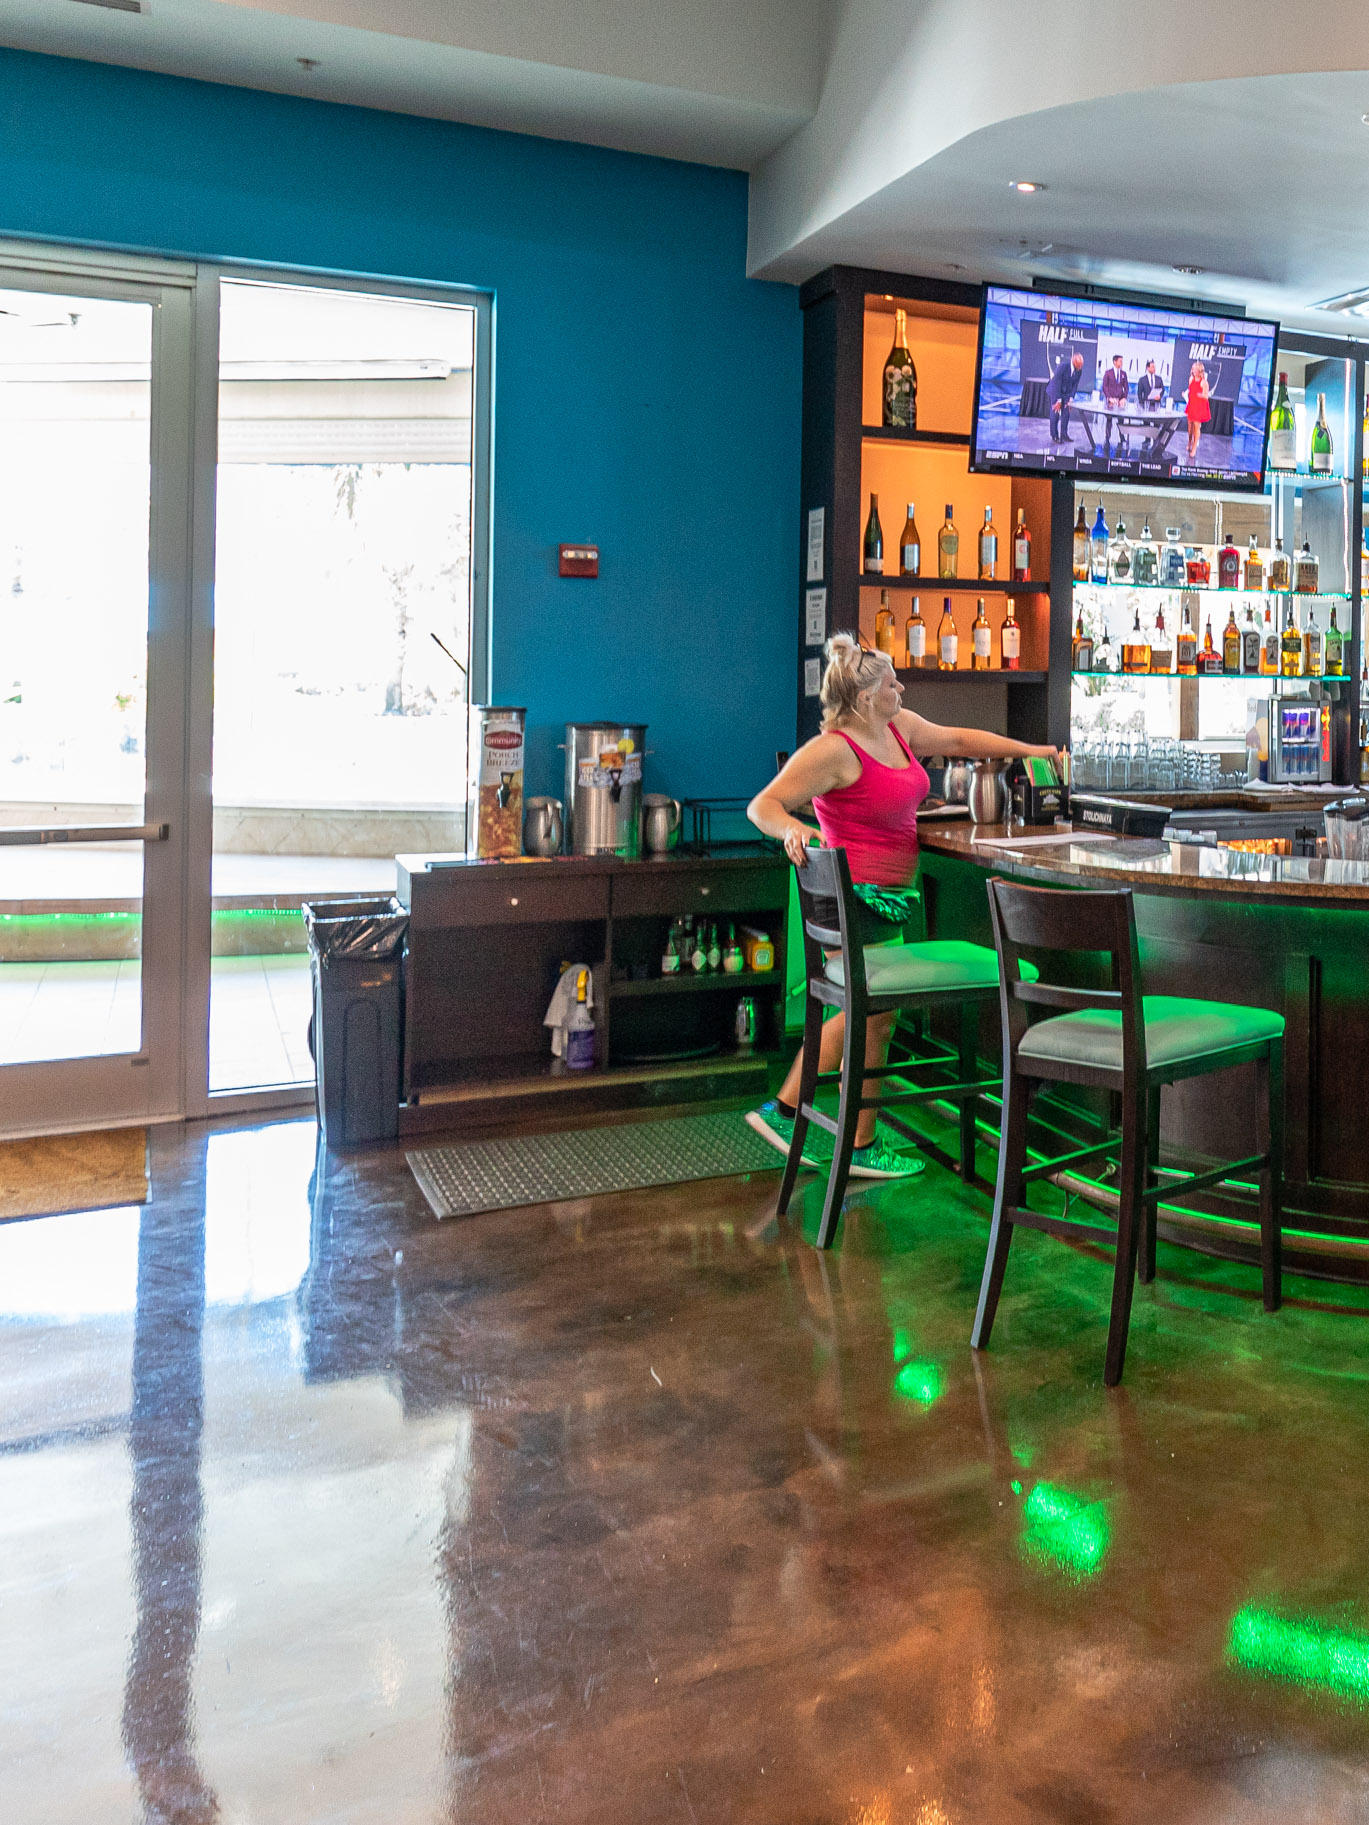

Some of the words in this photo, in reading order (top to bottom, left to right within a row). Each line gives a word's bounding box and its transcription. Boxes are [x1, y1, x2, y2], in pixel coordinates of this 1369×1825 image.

[1038, 324, 1067, 344] HALF
[1069, 328, 1085, 340] FULL
[1189, 342, 1216, 361] HALF
[1218, 346, 1238, 357] EMPTY
[985, 450, 1009, 460] ESPN
